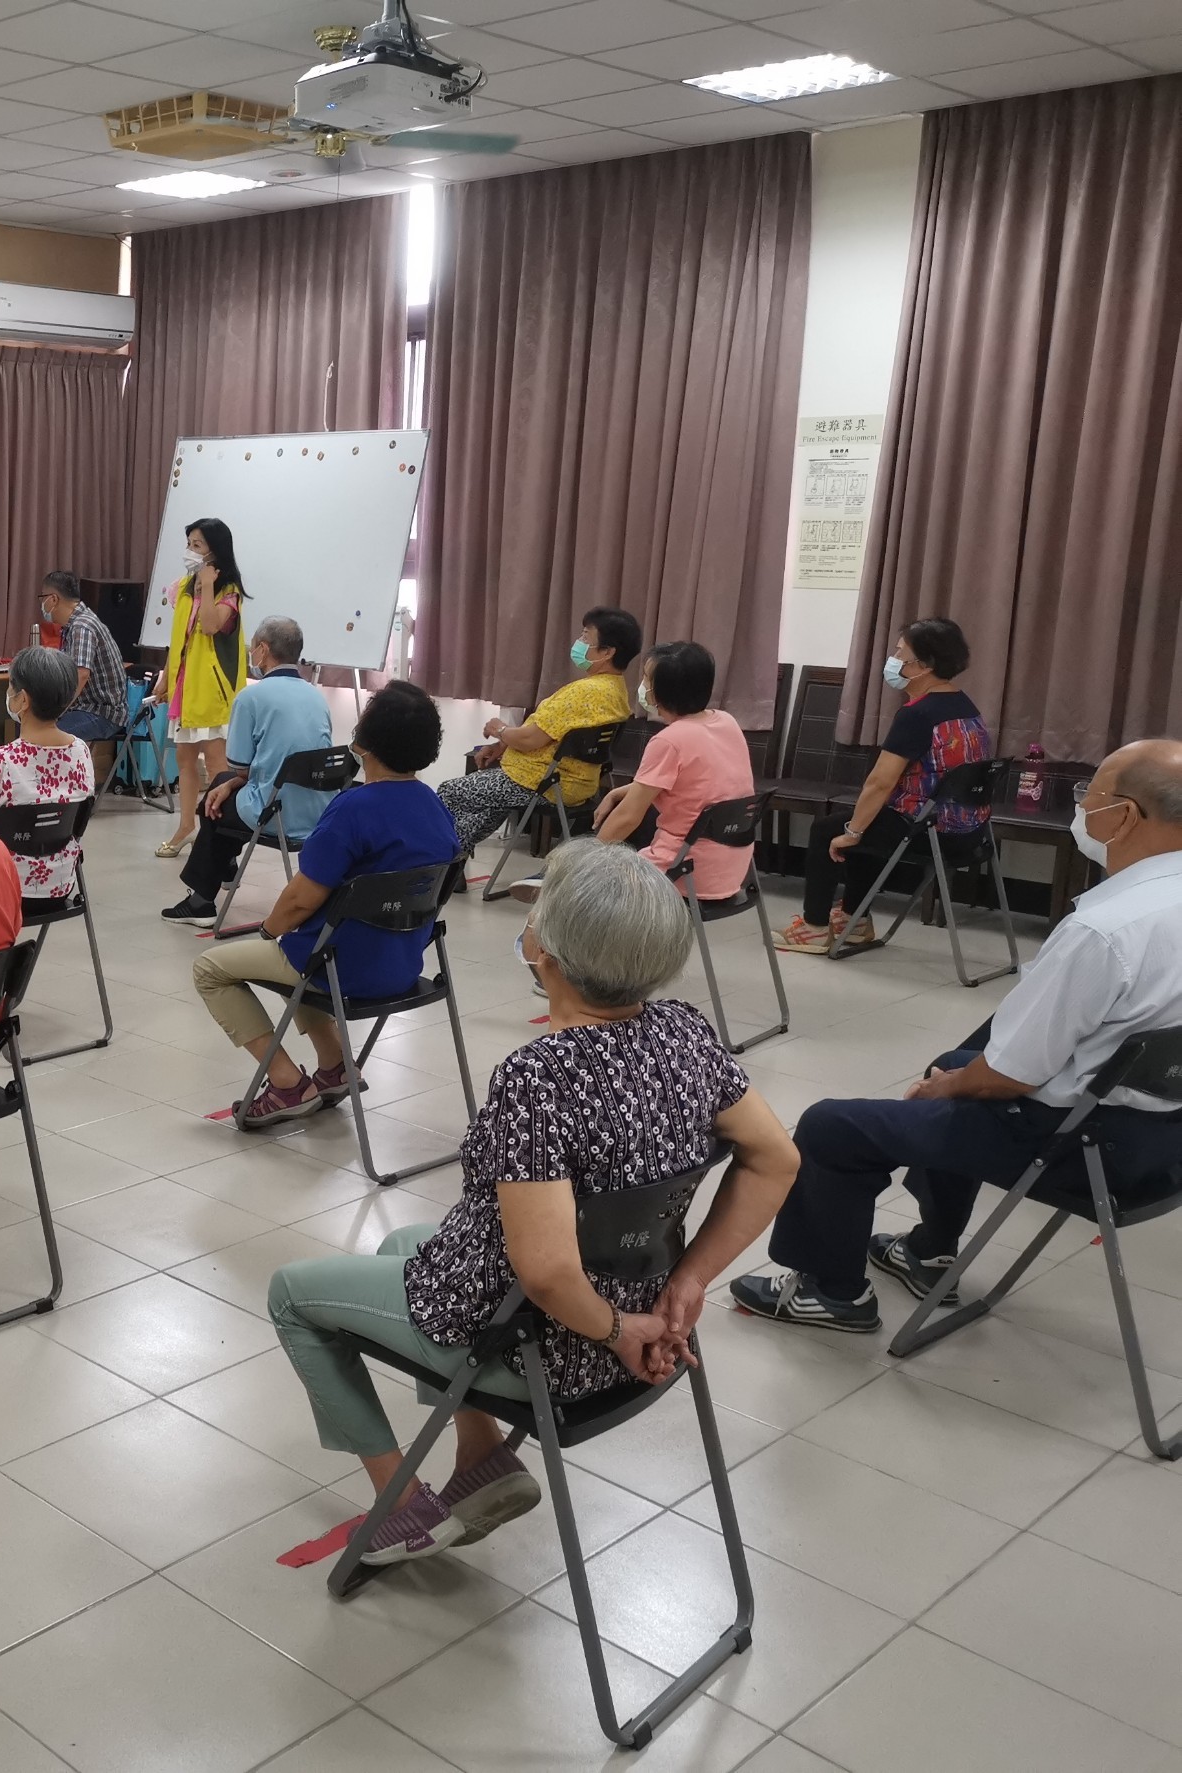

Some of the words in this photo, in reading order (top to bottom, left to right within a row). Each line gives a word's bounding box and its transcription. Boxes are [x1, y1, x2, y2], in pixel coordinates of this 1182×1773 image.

[815, 419, 867, 433] 避難器具
[818, 435, 840, 443] Escape
[841, 434, 877, 442] Equipment
[620, 1231, 650, 1248] 興隆
[407, 1535, 426, 1548] Sport
